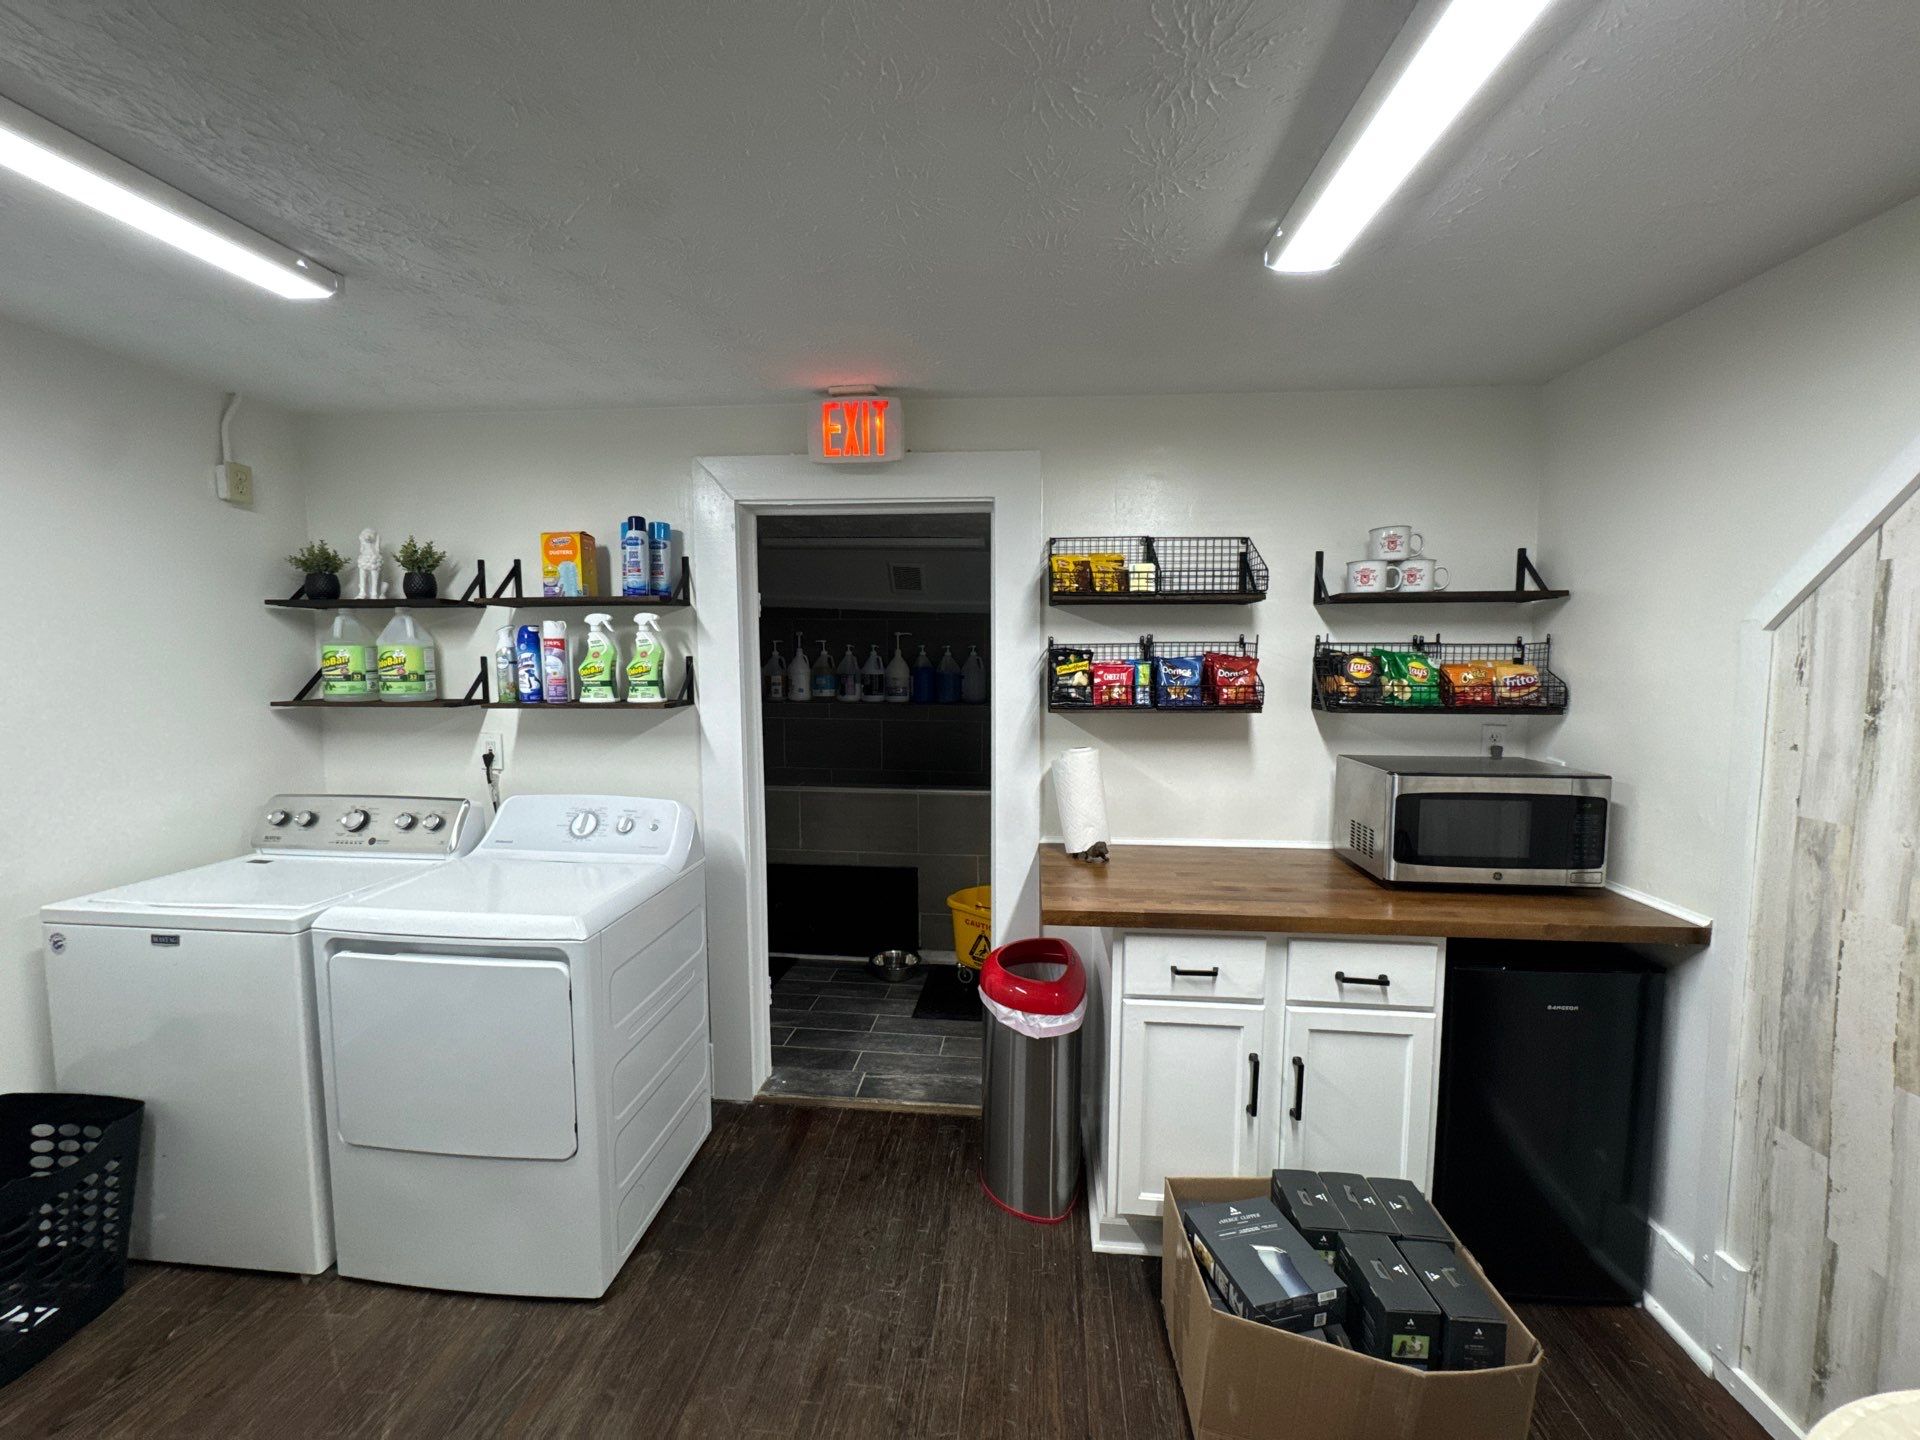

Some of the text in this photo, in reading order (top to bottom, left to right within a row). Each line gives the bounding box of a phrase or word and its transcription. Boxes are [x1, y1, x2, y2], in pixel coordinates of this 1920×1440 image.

[822, 400, 889, 457] EXIT
[322, 656, 349, 667] doBan
[1162, 666, 1192, 677] Doritos
[1218, 668, 1249, 677] Doritos
[1350, 662, 1372, 673] Lay's
[965, 919, 991, 930] CAUTI
